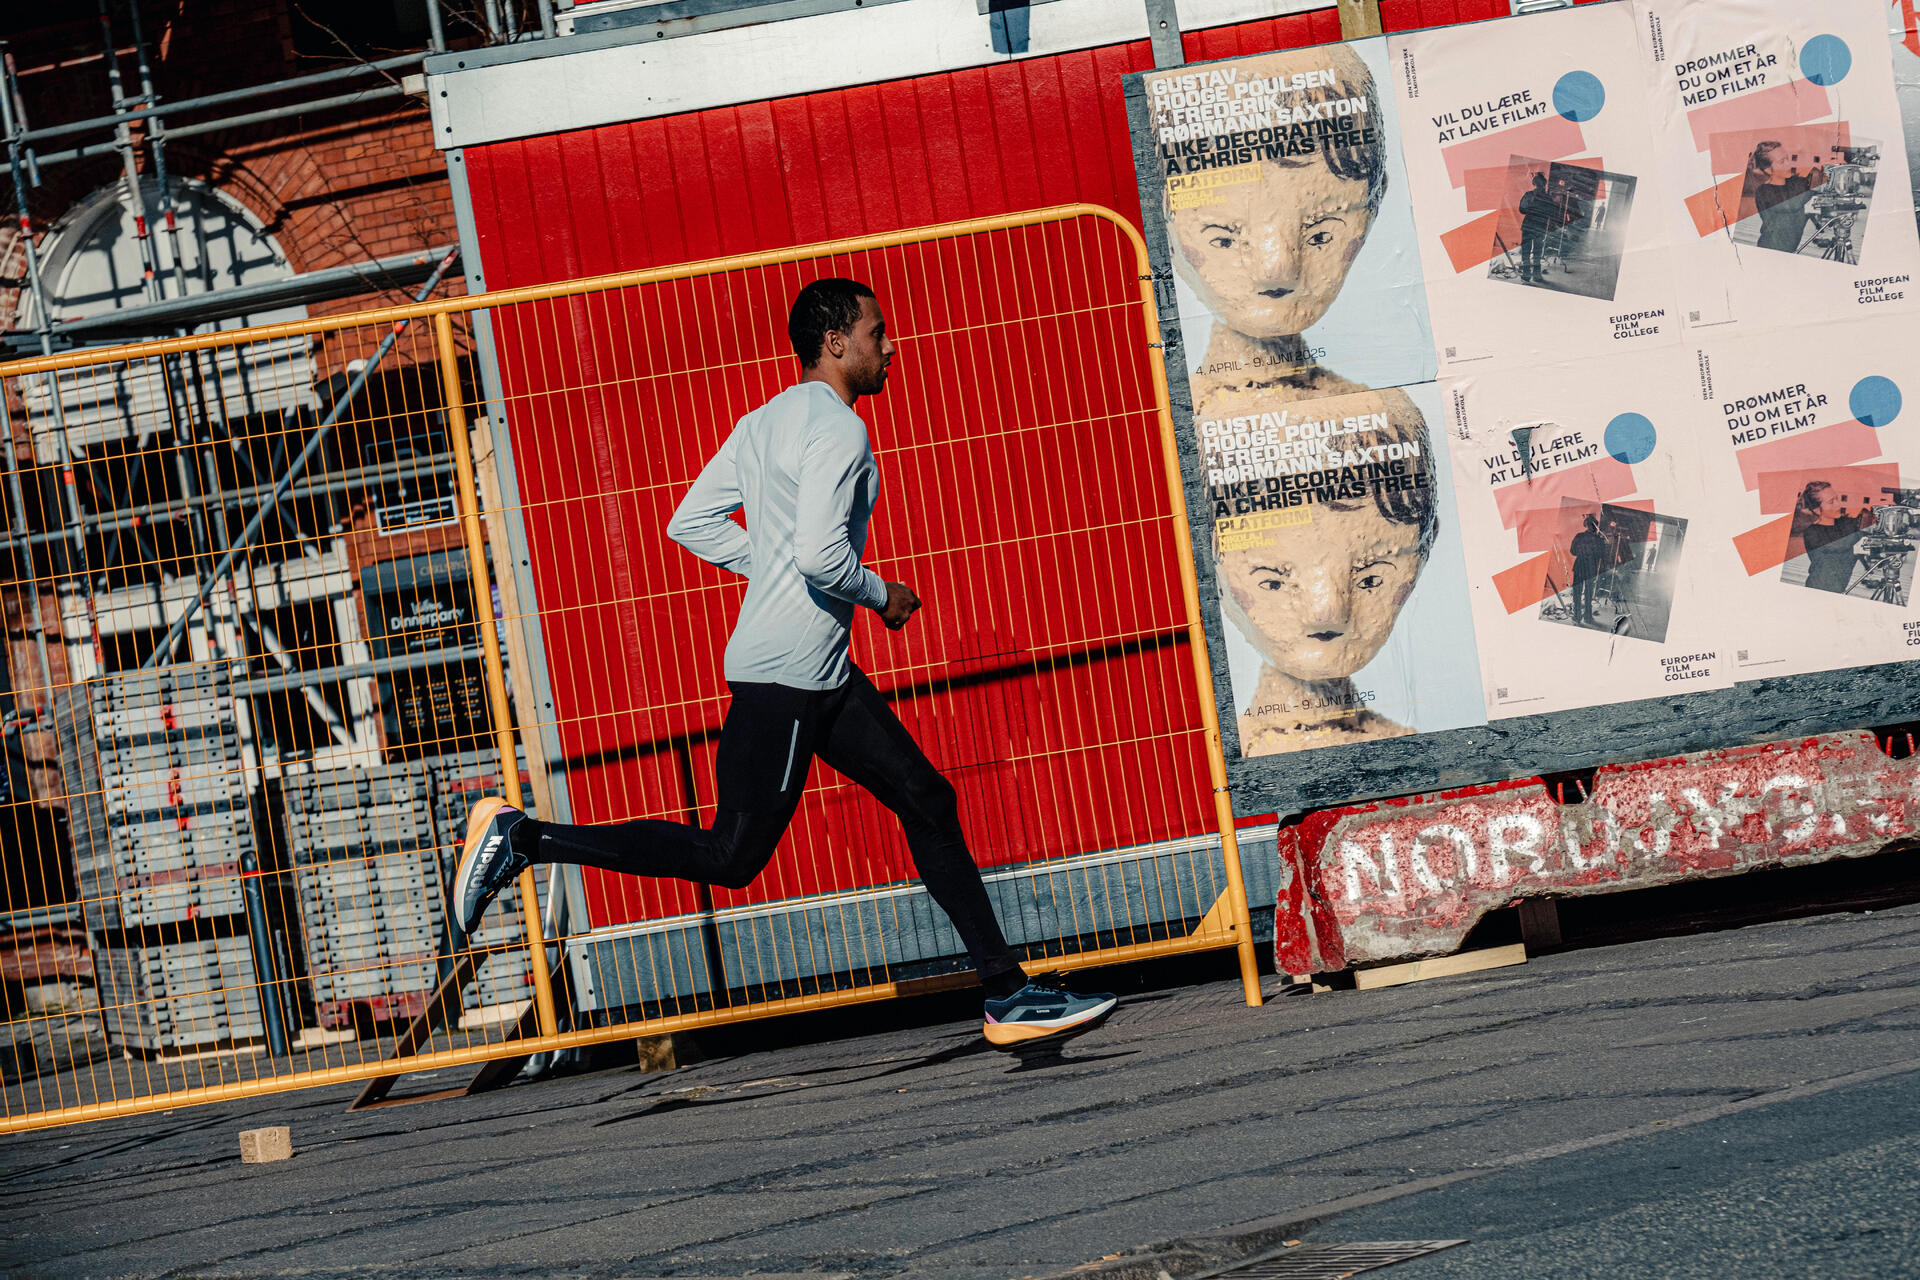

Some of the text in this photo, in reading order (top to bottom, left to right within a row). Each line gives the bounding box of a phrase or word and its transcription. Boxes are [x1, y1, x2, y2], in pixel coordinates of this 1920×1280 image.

[1675, 44, 1757, 77] DRØMMER
[1679, 53, 1777, 91] DU OM ET ÅR
[1152, 68, 1236, 95] GUSTAV
[1234, 68, 1336, 99] POULSEN
[1683, 73, 1766, 107] MED FILM?
[1159, 96, 1368, 144] RØRMANN SAXTON
[1172, 95, 1280, 125] FREDERIK
[1432, 90, 1532, 127] VIL DU LÆRE
[1438, 102, 1546, 143] AT LAVE FILM?
[1161, 115, 1353, 159] LIKE DECORATING
[1166, 128, 1376, 175] A CHRISTMAS TREE
[1170, 166, 1260, 191] PLATFORM
[1854, 274, 1910, 289] EUROPEAN
[1859, 286, 1884, 296] FILM
[1858, 292, 1904, 304] COLLEGE
[1610, 309, 1665, 324] EUROPEAN
[1615, 321, 1639, 331] FILM
[1614, 326, 1659, 339] COLLEGE
[1196, 366, 1206, 375] 4.
[1209, 362, 1242, 374] APRIL
[1267, 352, 1292, 366] JUNI
[1295, 347, 1326, 361] 2025
[1723, 384, 1807, 415] DRØMMER
[1728, 393, 1828, 430] DU OM ET ÅR
[1201, 410, 1288, 437] GUSTAV
[1285, 412, 1388, 442] POULSEN
[1732, 414, 1816, 445] MED FILM?
[1208, 440, 1420, 486] RØRMANN SAXTON
[1222, 437, 1331, 468] FREDERIK
[1484, 455, 1510, 470] VIL
[1540, 432, 1584, 454] LÆRE
[1490, 470, 1506, 485] AT
[1554, 444, 1598, 467] FILM?
[1211, 460, 1405, 501] LIKE DECORATING
[1215, 473, 1428, 517] A CHRISTMAS TREE
[1220, 509, 1309, 533] PLATFORM
[1660, 651, 1716, 666] EUROPEAN
[1666, 664, 1690, 673] FILM
[1664, 669, 1710, 682] COLLEGE
[1244, 707, 1255, 718] 4.
[1257, 703, 1290, 716] APRIL
[1316, 695, 1341, 708] JUNI
[1343, 690, 1376, 705] 2025
